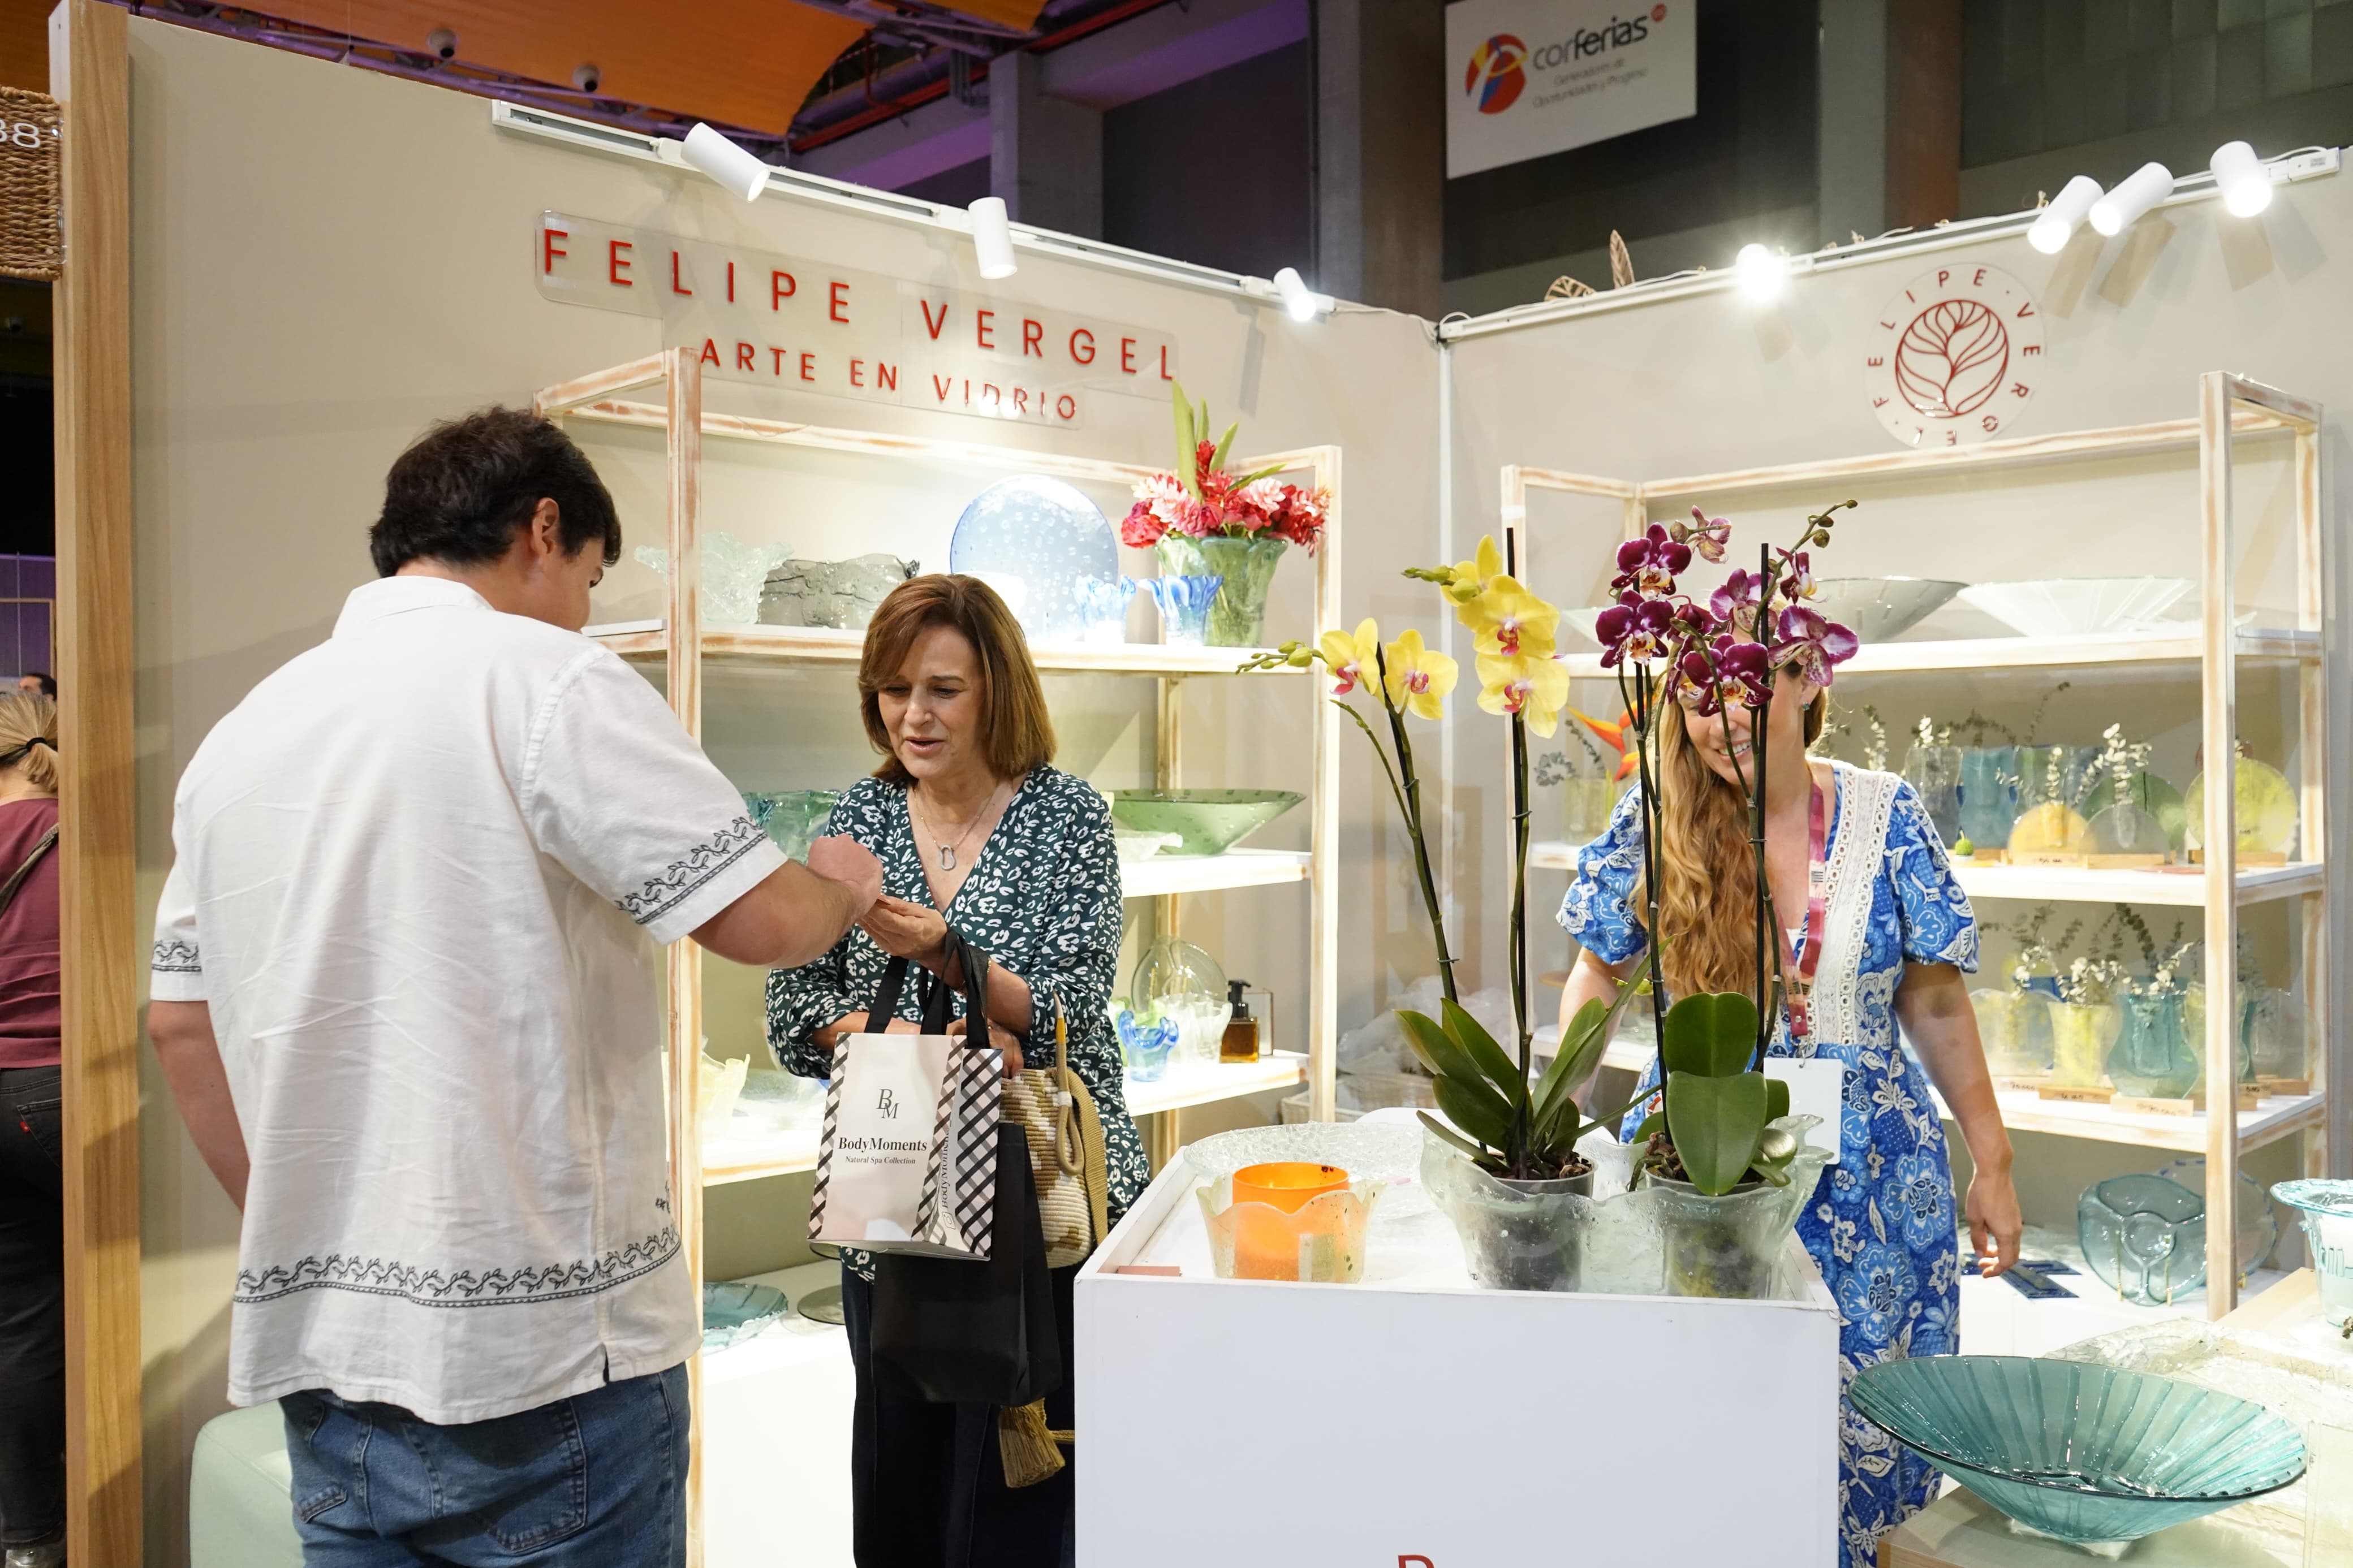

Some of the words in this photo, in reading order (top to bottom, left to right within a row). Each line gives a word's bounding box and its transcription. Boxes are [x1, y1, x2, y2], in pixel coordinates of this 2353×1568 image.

[1532, 15, 1648, 71] corferias
[0, 119, 40, 148] 8
[544, 228, 852, 325] FELIPE
[920, 300, 1174, 381] VERGEL
[1868, 268, 1988, 409] FELIPE
[700, 338, 816, 382] ARTE
[850, 360, 897, 391] EN
[933, 374, 1076, 420] VIDRIO
[1913, 301, 2041, 447] VERGEL
[838, 1137, 928, 1153] BodyMoments
